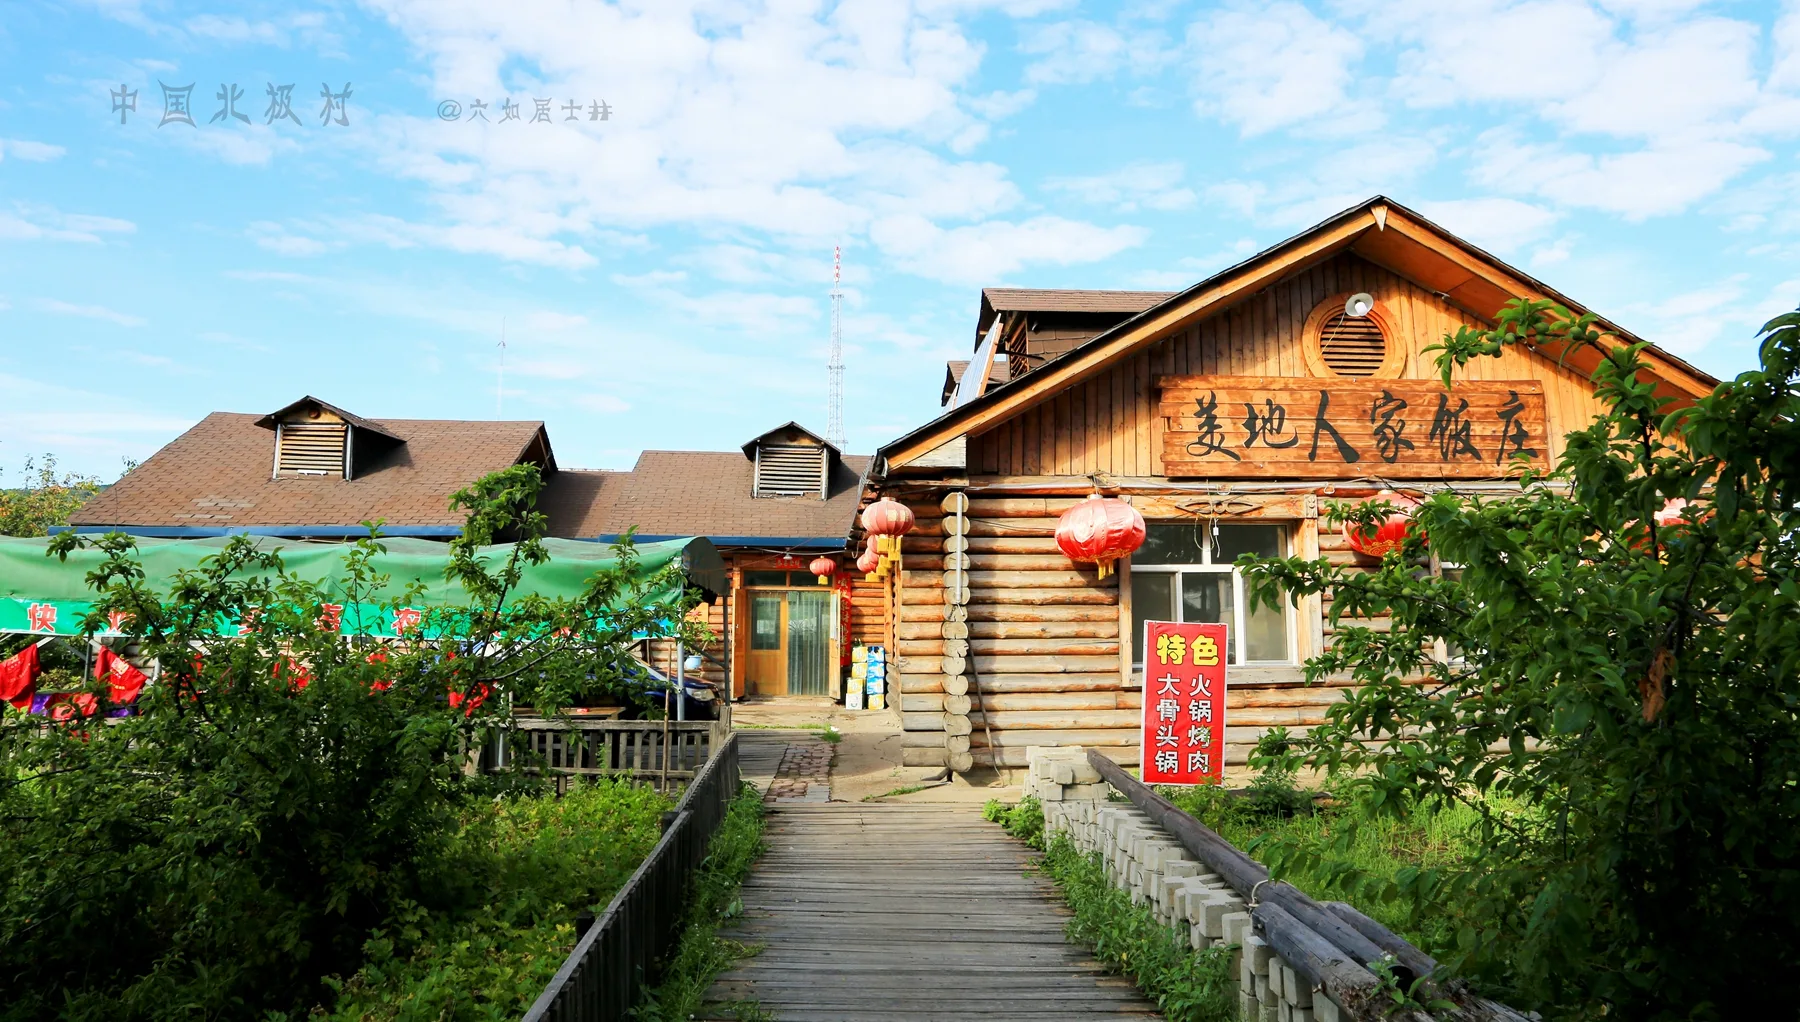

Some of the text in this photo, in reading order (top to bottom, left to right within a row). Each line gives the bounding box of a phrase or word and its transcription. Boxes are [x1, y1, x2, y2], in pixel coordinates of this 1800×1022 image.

[1186, 389, 1539, 466] 美地人家饭庄
[1156, 633, 1220, 666] 特色
[1155, 673, 1181, 774] 大骨头锅
[1187, 674, 1213, 774] 火锅烤肉
